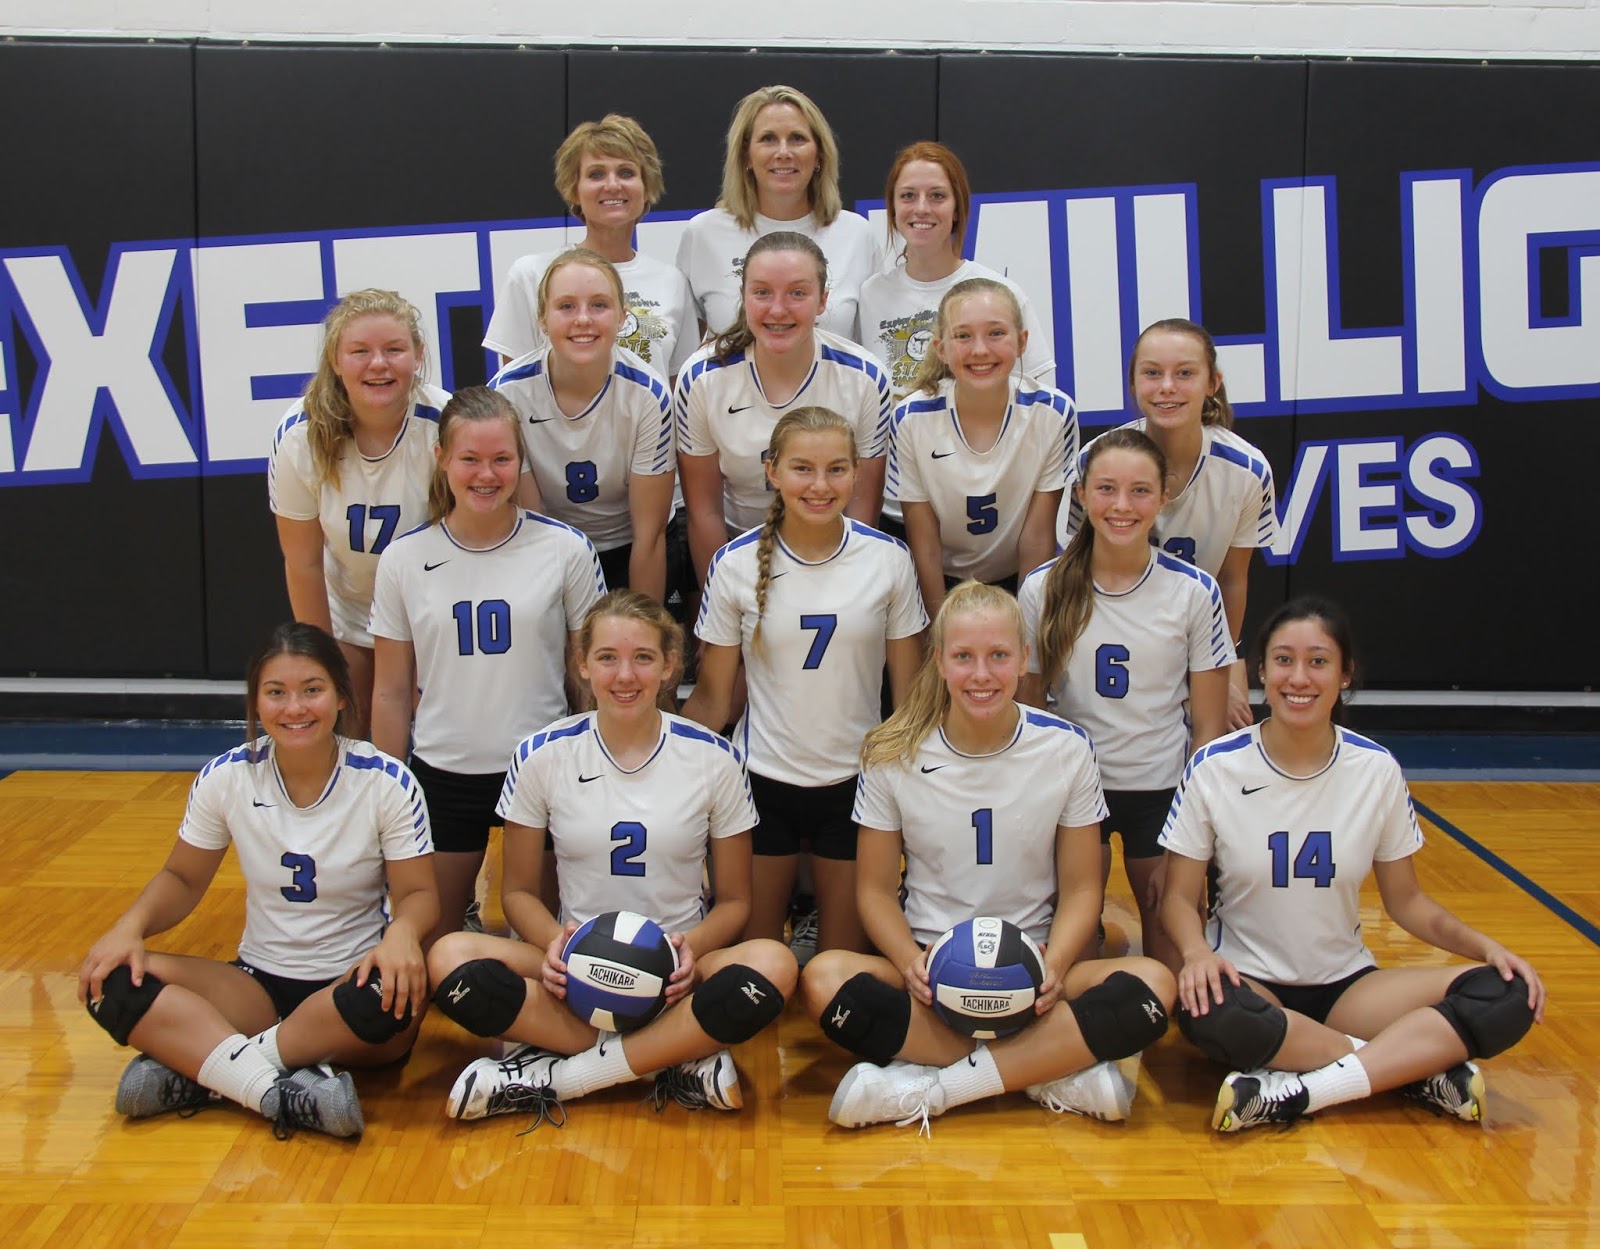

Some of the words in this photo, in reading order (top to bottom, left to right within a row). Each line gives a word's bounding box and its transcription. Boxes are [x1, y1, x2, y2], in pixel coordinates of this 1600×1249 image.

[565, 459, 599, 503] 8
[346, 503, 401, 554] 17
[966, 492, 998, 535] 5
[452, 598, 512, 656] 10
[800, 614, 837, 669] 7
[1095, 643, 1130, 699] 6
[610, 821, 647, 877] 2
[971, 808, 993, 865] 1
[1268, 831, 1335, 888] 14
[280, 851, 317, 903] 3
[587, 963, 637, 988] TACHIKARA
[960, 995, 1012, 1011] TACHIKARA
